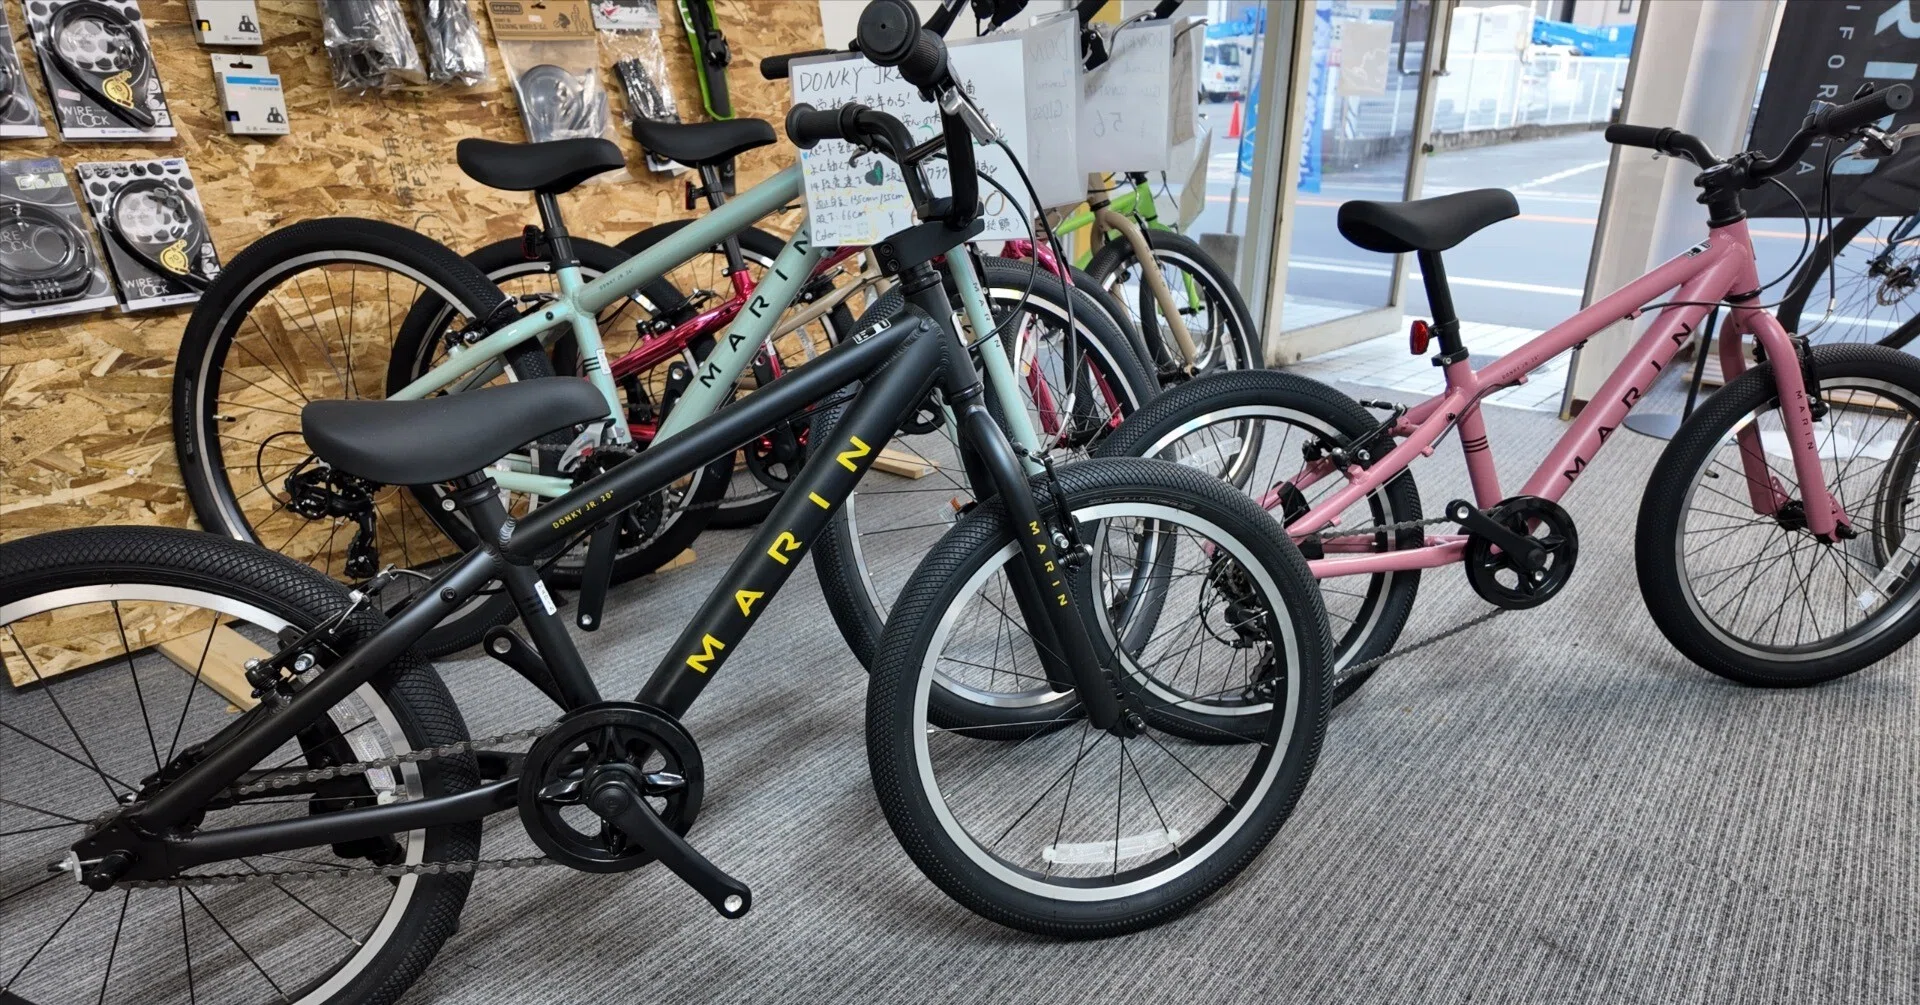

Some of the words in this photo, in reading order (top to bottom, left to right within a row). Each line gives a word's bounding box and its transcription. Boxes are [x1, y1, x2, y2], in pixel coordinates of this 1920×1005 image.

[800, 67, 862, 94] DONKY
[1796, 4, 1862, 176] IFORIA
[61, 105, 93, 116] WIRE
[76, 114, 111, 127] LOCK
[124, 277, 153, 289] WIRE
[139, 284, 170, 299] LOCK
[973, 282, 1001, 348] MARN
[1564, 323, 1692, 483] MARIN
[1794, 389, 1815, 450] MARIN
[553, 508, 582, 529] DONKY
[685, 435, 872, 674] MARIN
[1029, 520, 1068, 607] MARIN
